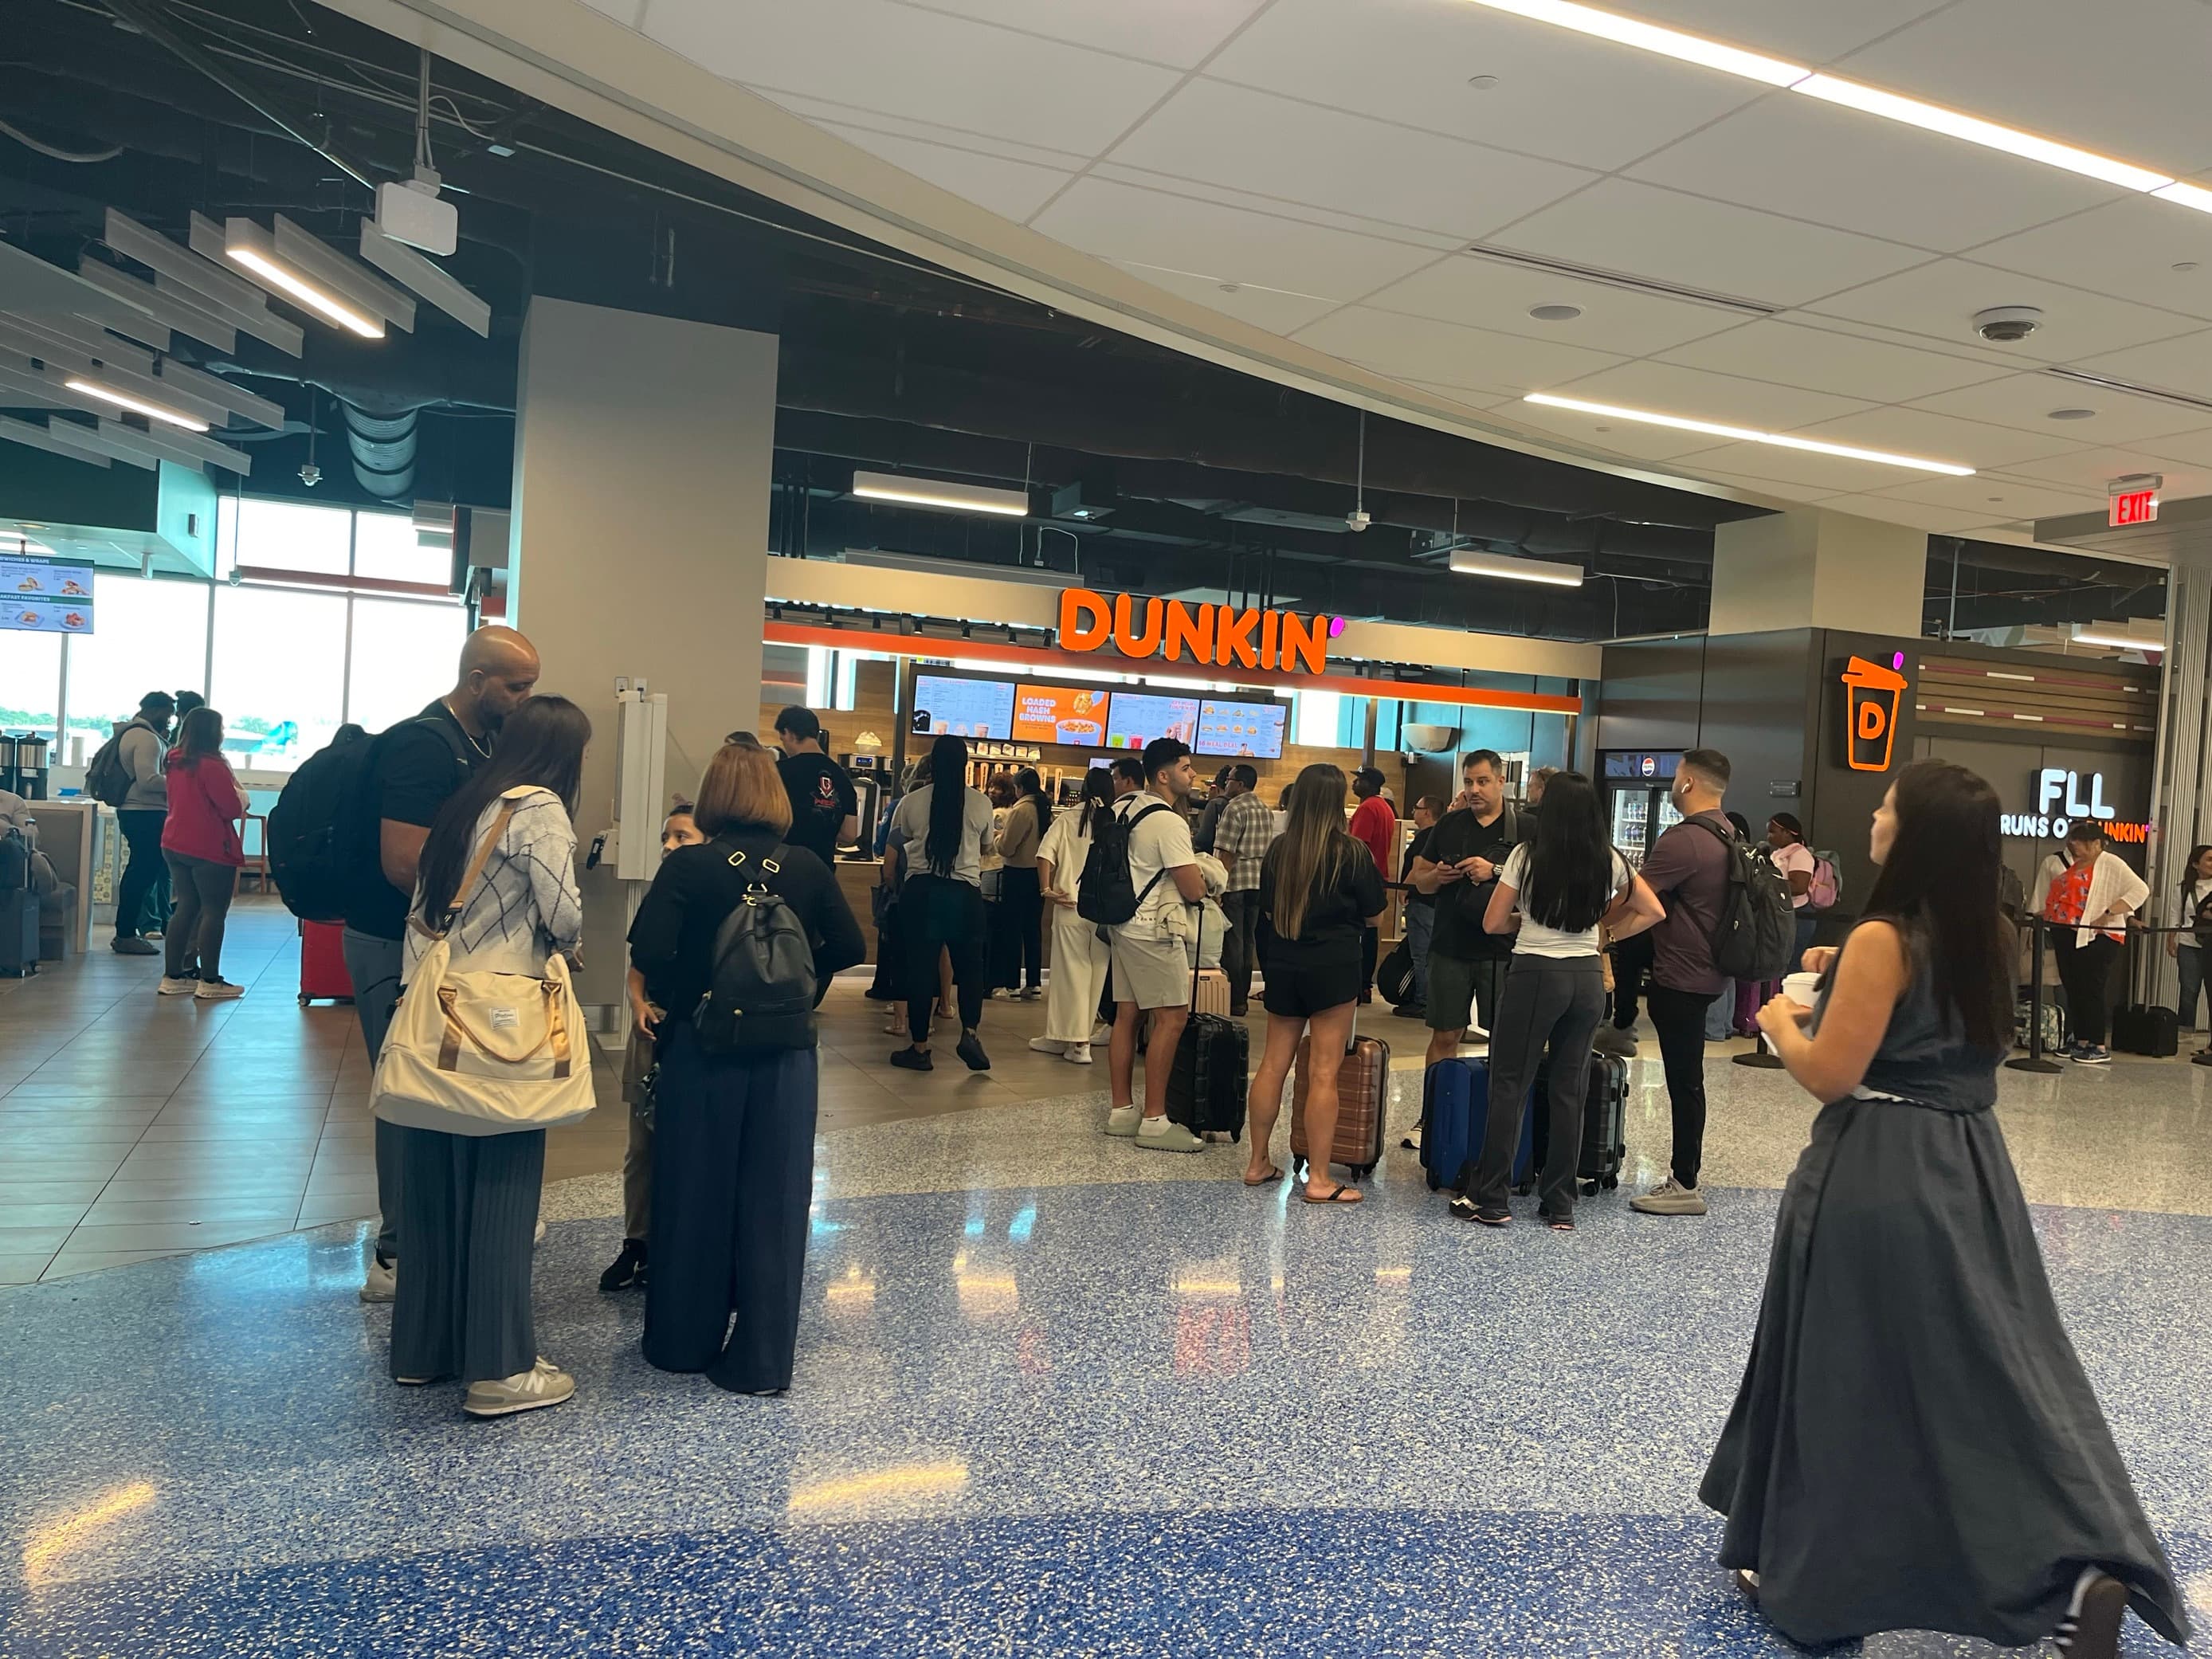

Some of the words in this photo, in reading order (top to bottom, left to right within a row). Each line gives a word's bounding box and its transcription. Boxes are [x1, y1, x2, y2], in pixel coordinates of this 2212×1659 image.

[2117, 490, 2153, 524] EXIT
[1060, 588, 1346, 675] DUNKIN'
[1019, 713, 1056, 723] BROWNS
[1022, 697, 1056, 707] LOADED
[1858, 701, 1885, 739] D
[2039, 768, 2115, 819] FLL
[2000, 814, 2049, 837] RUNS
[2053, 818, 2073, 838] O
